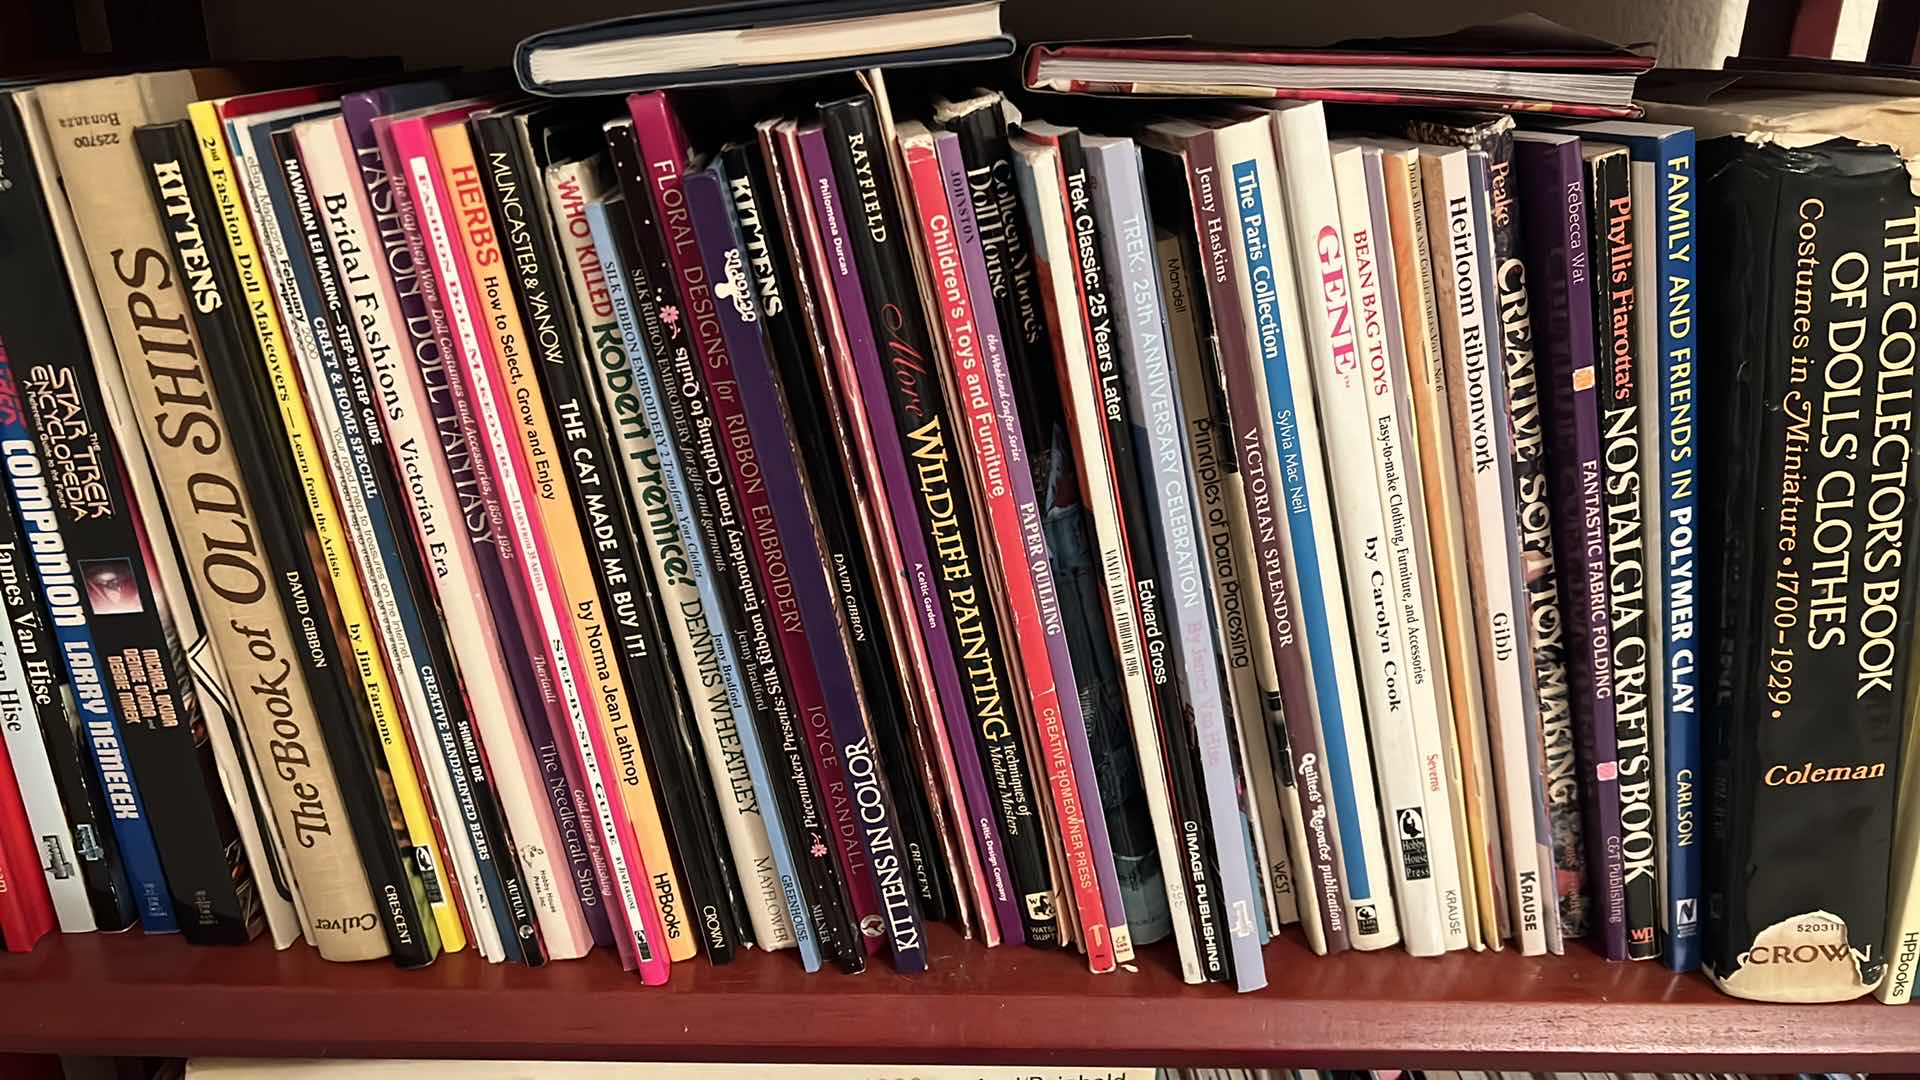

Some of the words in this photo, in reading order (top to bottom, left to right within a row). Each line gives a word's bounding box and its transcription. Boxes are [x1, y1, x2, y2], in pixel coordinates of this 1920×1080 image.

[58, 112, 120, 128] Bonanza
[452, 164, 498, 266] HERBS
[848, 133, 886, 242] RAYFIELD
[1068, 168, 1088, 211] Trek
[1238, 171, 1257, 208] The
[1489, 161, 1512, 226] Peake
[1667, 156, 1689, 260] FAMILY
[154, 160, 222, 313] KITTENS
[201, 136, 220, 161] 2nd
[212, 168, 243, 246] Fashion
[237, 253, 260, 293] Doll
[251, 299, 290, 401] Makeovers
[557, 178, 591, 239] WHO
[576, 243, 614, 317] KILLED
[730, 176, 783, 316] KITTENS
[930, 214, 966, 318] Children's
[1075, 214, 1101, 289] Classic:
[1244, 214, 1266, 260] Paris
[1353, 229, 1373, 288] BEAN
[1609, 195, 1632, 281] Phyllis
[1882, 206, 1920, 295] THE
[483, 275, 502, 310] How
[1088, 293, 1106, 316] 25
[1315, 225, 1361, 374] GENE
[1792, 198, 1823, 348] Costumes
[1830, 252, 1869, 308] OF
[494, 314, 507, 330] to
[1252, 265, 1279, 358] Collection
[1362, 294, 1380, 337] BAG
[1449, 197, 1475, 316] Heirloom
[1463, 325, 1493, 473] Ribbonwork
[1669, 276, 1689, 338] AND
[110, 245, 222, 458] SHIPS
[500, 334, 523, 384] Select,
[604, 261, 621, 293] SILK
[614, 297, 638, 352] RIBBON
[631, 356, 666, 448] EMBROIDERY
[954, 320, 976, 369] Toys
[1093, 321, 1113, 371] Years
[1368, 341, 1388, 395] TOYS
[1494, 258, 1541, 461] CREATIVE
[1612, 290, 1633, 398] Fiarotta's
[1791, 356, 1814, 382] in
[323, 192, 369, 283] Bridal
[354, 292, 404, 420] Fashions
[399, 438, 436, 535] Victorian
[429, 541, 449, 578] Era
[516, 387, 534, 425] Grow
[653, 159, 694, 254] FLORAL
[683, 266, 728, 368] DESIGNS
[715, 379, 735, 403] for
[726, 413, 763, 493] RIBBON
[751, 505, 802, 633] EMBROIDERY
[966, 373, 987, 408] and
[1102, 375, 1122, 421] Later
[1669, 348, 1690, 460] FRIENDS
[1820, 317, 1865, 459] DOLLS'
[31, 365, 85, 520] ENCYCLOPEDIA
[47, 363, 87, 439] STAR
[73, 445, 110, 518] TREK
[527, 429, 545, 456] and
[559, 398, 586, 440] THE
[1276, 409, 1295, 449] Sylvia
[1864, 302, 1915, 571] COLLECTOR'S
[534, 459, 555, 500] Enjoy
[572, 447, 598, 484] CAT
[975, 412, 1005, 496] Furniture
[1191, 417, 1221, 504] Principles
[1284, 453, 1299, 481] Mac
[1671, 470, 1691, 498] IN
[1777, 391, 1811, 550] Miniature
[2, 438, 84, 627] COMPANION
[585, 493, 616, 552] MADE
[1208, 508, 1227, 528] of
[1290, 486, 1307, 513] Neil
[1518, 475, 1554, 576] SOFT
[1582, 460, 1602, 556] FANTASTIC
[1604, 406, 1643, 628] NOSTALGIA
[183, 470, 267, 607] OLD
[1019, 501, 1043, 556] PAPER
[1031, 560, 1063, 635] QUILLING
[1212, 533, 1233, 577] Data
[1243, 427, 1275, 542] VICTORIAN
[1263, 548, 1293, 647] SPLENDOR
[1808, 470, 1855, 649] CLOTHES
[603, 557, 626, 585] ME
[833, 553, 851, 592] DAVID
[845, 595, 865, 641] GIBBON
[908, 416, 970, 581] WILDLIFE
[949, 586, 1008, 740] PAINTING
[916, 570, 928, 595] Celtic
[923, 597, 936, 628] Garden
[1589, 562, 1606, 621] FABRIC
[1670, 507, 1692, 640] POLYMER
[230, 618, 275, 663] of
[286, 570, 309, 614] DAVID
[301, 616, 326, 668] GIBBON
[613, 590, 638, 627] BUY
[1137, 579, 1161, 637] Edward
[1220, 580, 1249, 668] Processing
[1492, 612, 1512, 661] Gibb
[1529, 580, 1561, 649] TOY
[1857, 579, 1898, 698] BOOK
[624, 633, 646, 658] IT!
[1148, 639, 1167, 684] Gross
[1593, 626, 1610, 698] FOLDING
[348, 622, 361, 640] by
[355, 647, 372, 677] Jim
[366, 681, 392, 744] Faraone
[680, 598, 723, 687] DENNIS
[707, 691, 760, 816] WHEATLEY
[1613, 636, 1649, 775] CRAFTS
[1671, 649, 1693, 712] CLAY
[64, 640, 106, 714] LARRY
[88, 719, 138, 819] NEMECEK
[249, 658, 313, 781] Book
[1537, 663, 1576, 803] MAKING
[421, 665, 449, 729] CREATIVE
[441, 732, 477, 820] HANDPAINTED
[469, 822, 489, 860] BEARS
[844, 737, 885, 823] COLOR
[1764, 759, 1886, 788] Coleman
[288, 781, 331, 848] The
[1042, 707, 1065, 768] CREATIVE
[1056, 769, 1083, 849] HOMEOWNER
[1074, 851, 1092, 888] PRESS
[1675, 769, 1694, 845] CARLSON
[866, 825, 894, 853] IN
[1403, 840, 1425, 852] Hobby
[1404, 854, 1428, 864] House
[1607, 836, 1619, 859] C&T
[1619, 781, 1654, 883] BOOK
[506, 878, 525, 919] MUTUAL
[653, 872, 681, 938] HPBooks
[874, 854, 919, 951] KITTENS
[1185, 832, 1204, 881] IMAGE
[1195, 884, 1220, 971] PUBLISHING
[1269, 860, 1290, 894] WEST
[1406, 867, 1430, 878] Press
[1519, 871, 1538, 930] KRAUSE
[1608, 864, 1622, 922] Publishing
[316, 913, 377, 933] Culver
[384, 884, 411, 944] CRESCENT
[702, 905, 725, 948] CROWN
[781, 874, 808, 941] GREENHOUSE
[811, 904, 830, 943] MILNER
[1444, 889, 1462, 935] KRAUSE
[1748, 943, 1872, 965] CROWN
[1892, 931, 1918, 997] HPBooks
